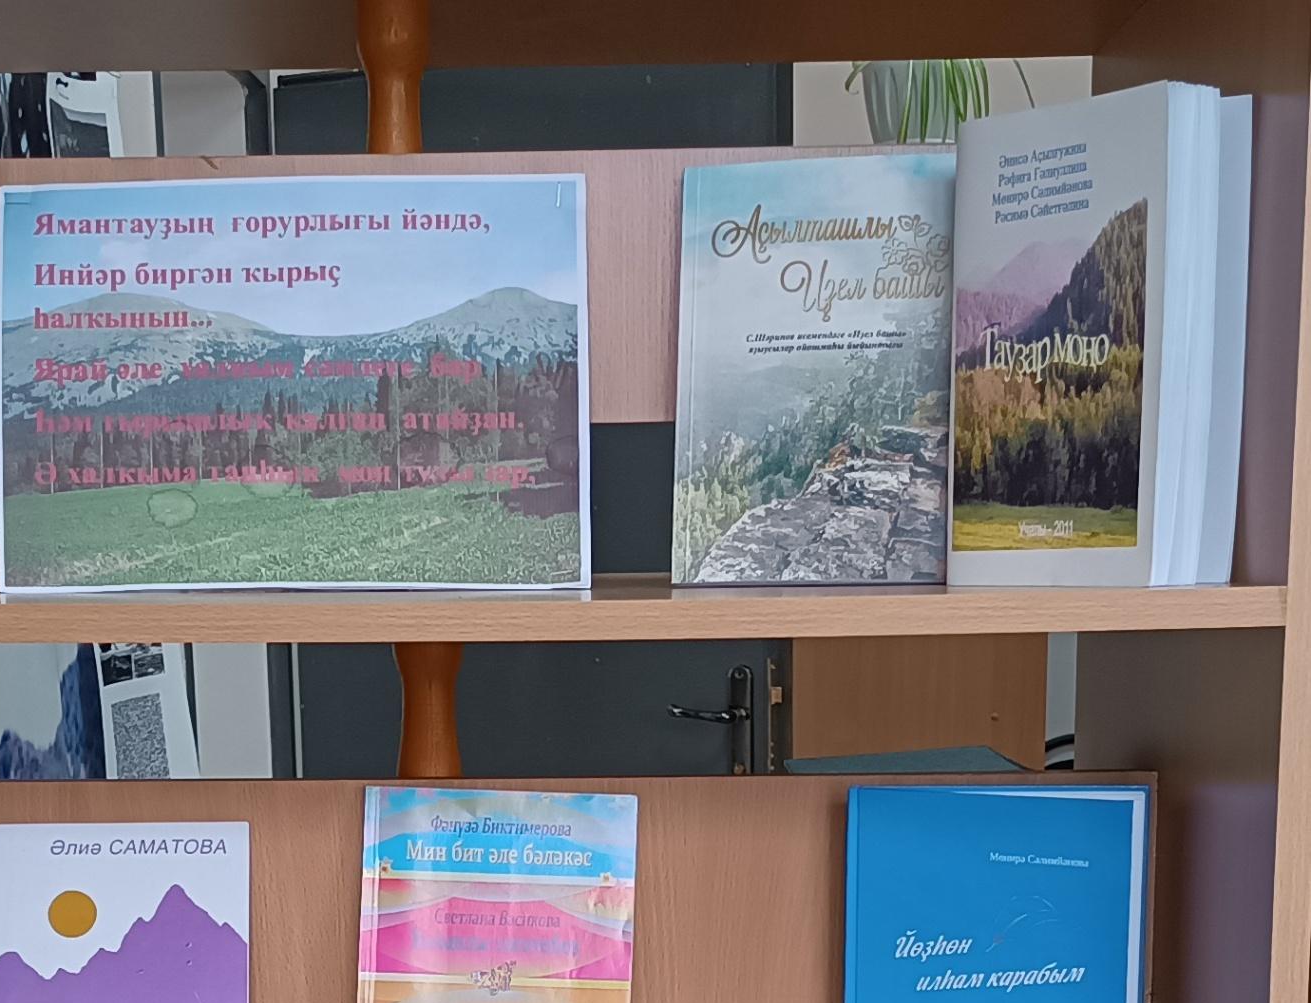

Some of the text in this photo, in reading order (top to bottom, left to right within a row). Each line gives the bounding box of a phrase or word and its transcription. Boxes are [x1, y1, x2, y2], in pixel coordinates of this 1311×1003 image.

[33, 213, 215, 240] Ямантауҙың
[34, 262, 126, 292] Инйәр
[135, 261, 233, 291] биргән
[1052, 331, 1110, 374] моңо
[34, 358, 110, 389] Ярай
[1053, 519, 1074, 537] 2011
[481, 817, 572, 840] Биктимерова
[49, 838, 228, 856] Әлиә САМАТОВА
[406, 839, 593, 867] Мин бит әле бәләкәс
[916, 961, 1086, 993] илһам карабым
